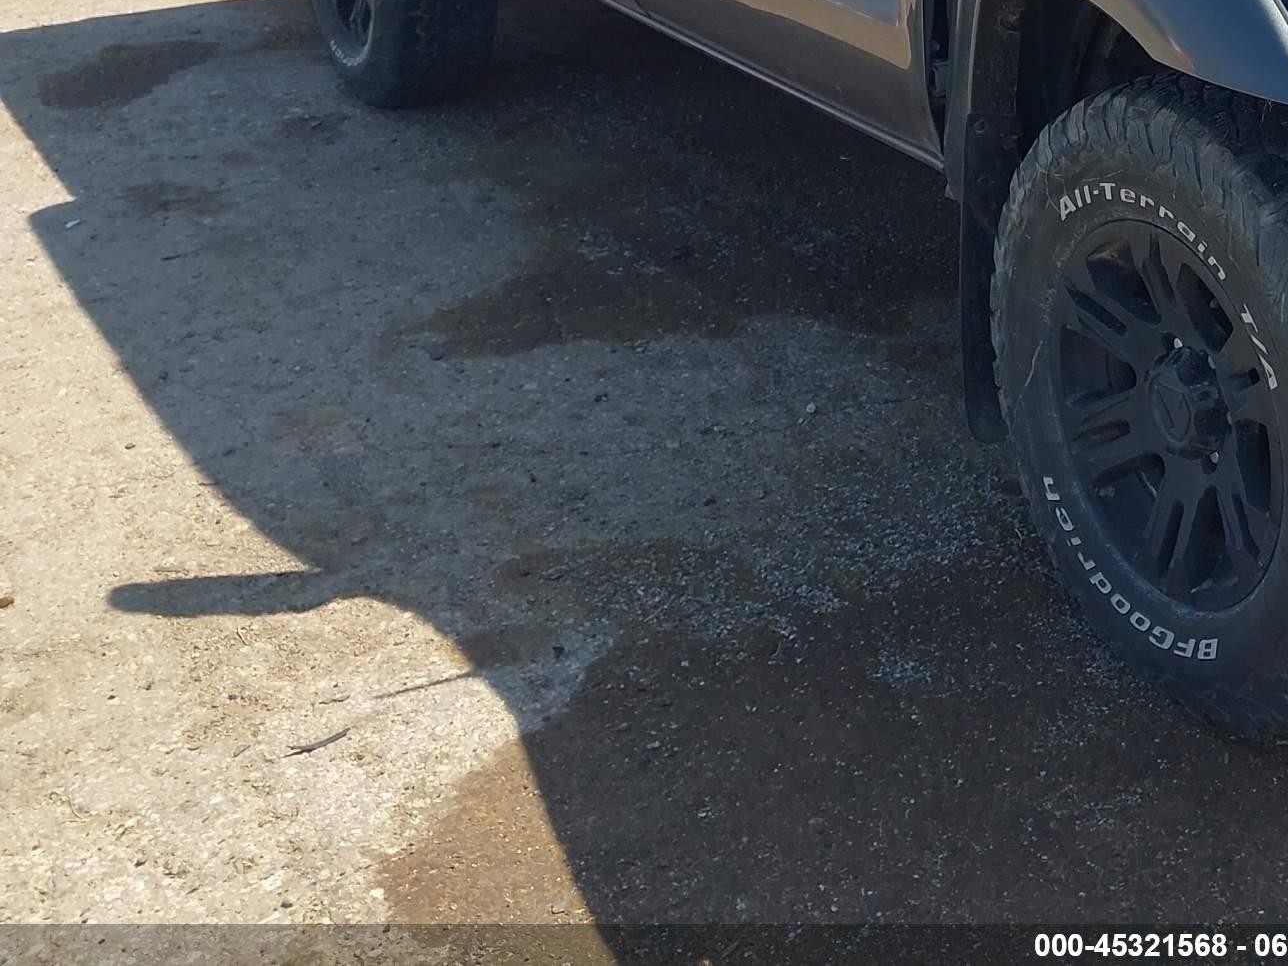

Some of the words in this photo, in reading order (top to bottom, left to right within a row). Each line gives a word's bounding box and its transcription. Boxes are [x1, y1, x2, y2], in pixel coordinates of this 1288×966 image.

[1058, 182, 1228, 282] All-Terrain
[1239, 303, 1279, 392] T/A
[1042, 475, 1220, 661] BFGoodrich
